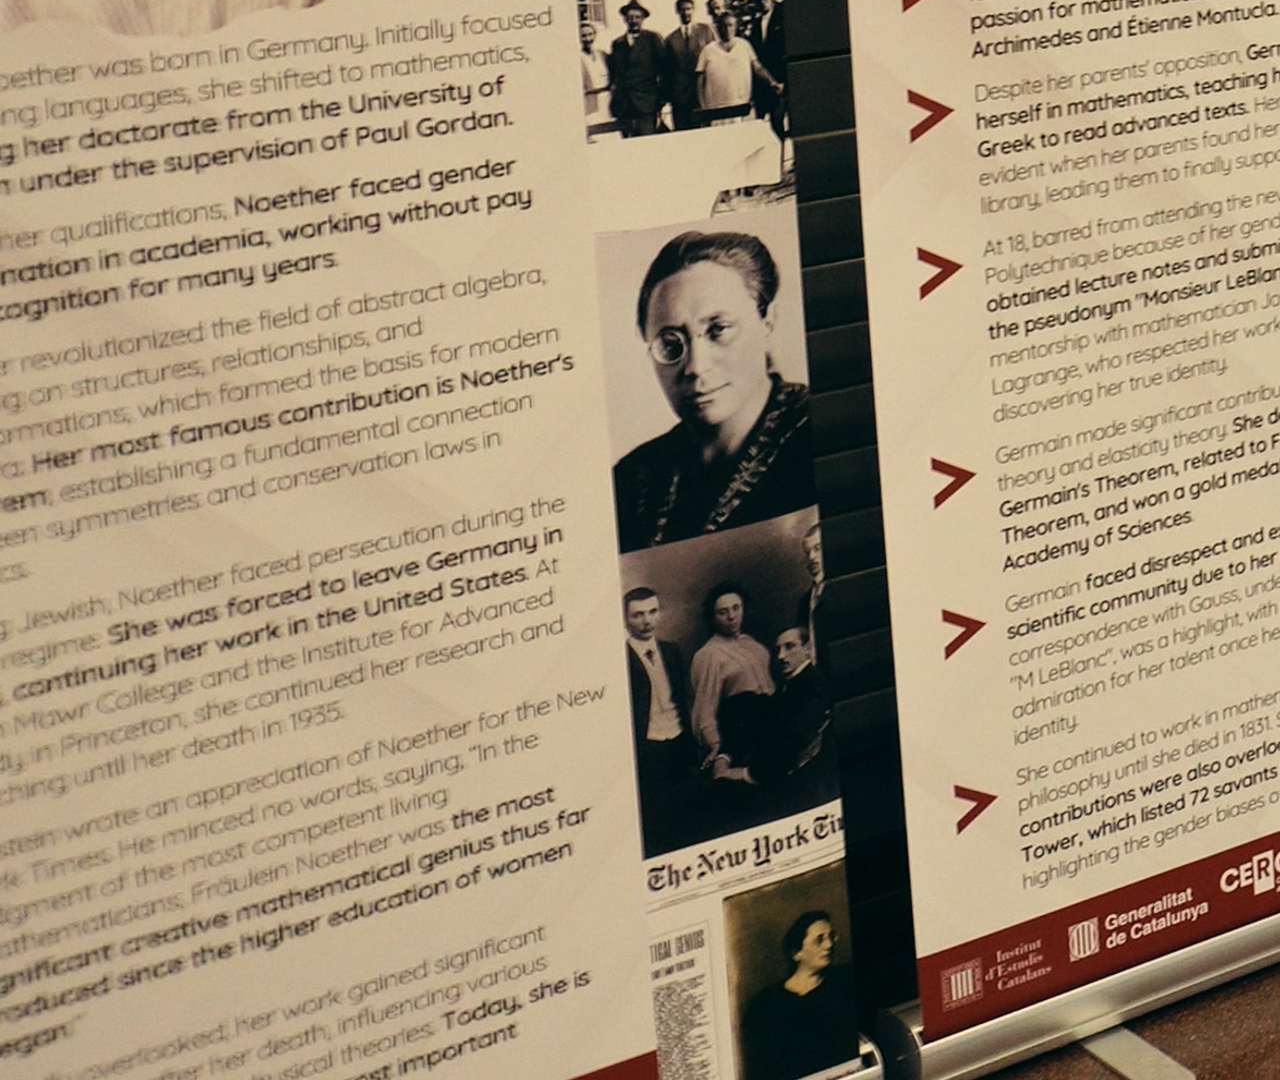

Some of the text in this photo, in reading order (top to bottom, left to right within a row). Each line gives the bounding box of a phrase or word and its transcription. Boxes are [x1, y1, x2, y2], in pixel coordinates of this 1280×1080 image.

[970, 6, 1043, 35] passion
[1048, 1, 1076, 19] for
[971, 1, 1280, 59] Archimedes and Étienne Montucla.
[22, 75, 505, 159] her doctorate from the University of
[19, 111, 515, 193] under the supervision of Paul Gordan.
[1021, 832, 1084, 863] Tower,
[1087, 812, 1136, 840] which
[1141, 794, 1186, 823] listed
[1190, 787, 1210, 807] 72
[1213, 765, 1278, 798] savants
[647, 864, 692, 892] The
[696, 848, 747, 880] New
[750, 823, 811, 867] York
[1105, 887, 1193, 931] Generalitat
[1106, 901, 1209, 950] de Catalunya
[984, 953, 1043, 982] d'Estudis
[996, 939, 1043, 963] Institut
[997, 965, 1052, 991] Catalans
